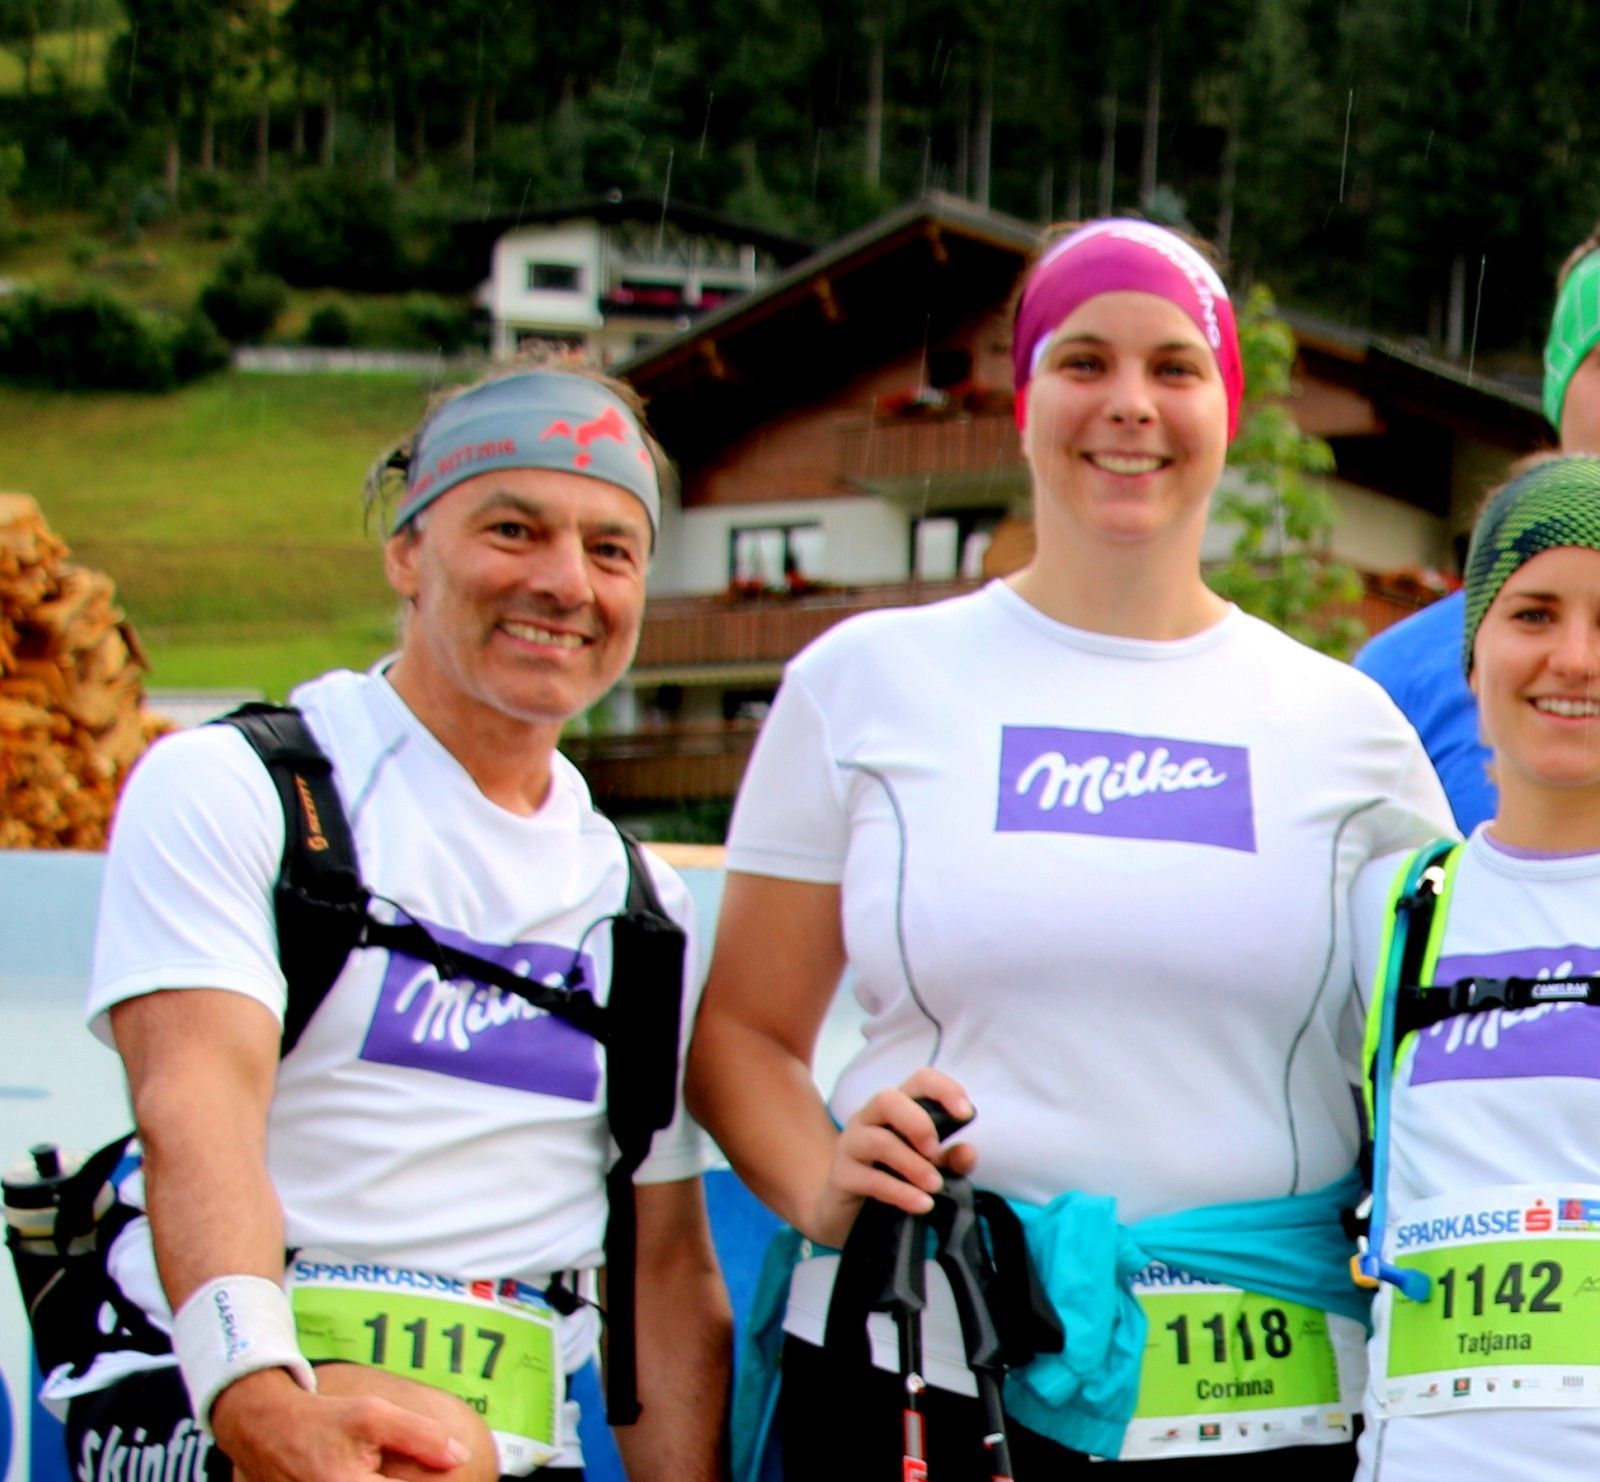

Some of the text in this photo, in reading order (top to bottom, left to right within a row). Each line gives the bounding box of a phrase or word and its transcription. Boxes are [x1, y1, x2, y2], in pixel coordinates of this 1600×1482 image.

[1016, 747, 1228, 814] Milka
[1396, 1208, 1521, 1249] SPARKASSE
[295, 1261, 467, 1297] SPARKASSE
[1437, 1259, 1563, 1320] 1142
[363, 1312, 506, 1380] 1117
[1165, 1308, 1293, 1366] 1118
[1457, 1330, 1532, 1356] Tatjana
[1195, 1376, 1274, 1401] Corinna
